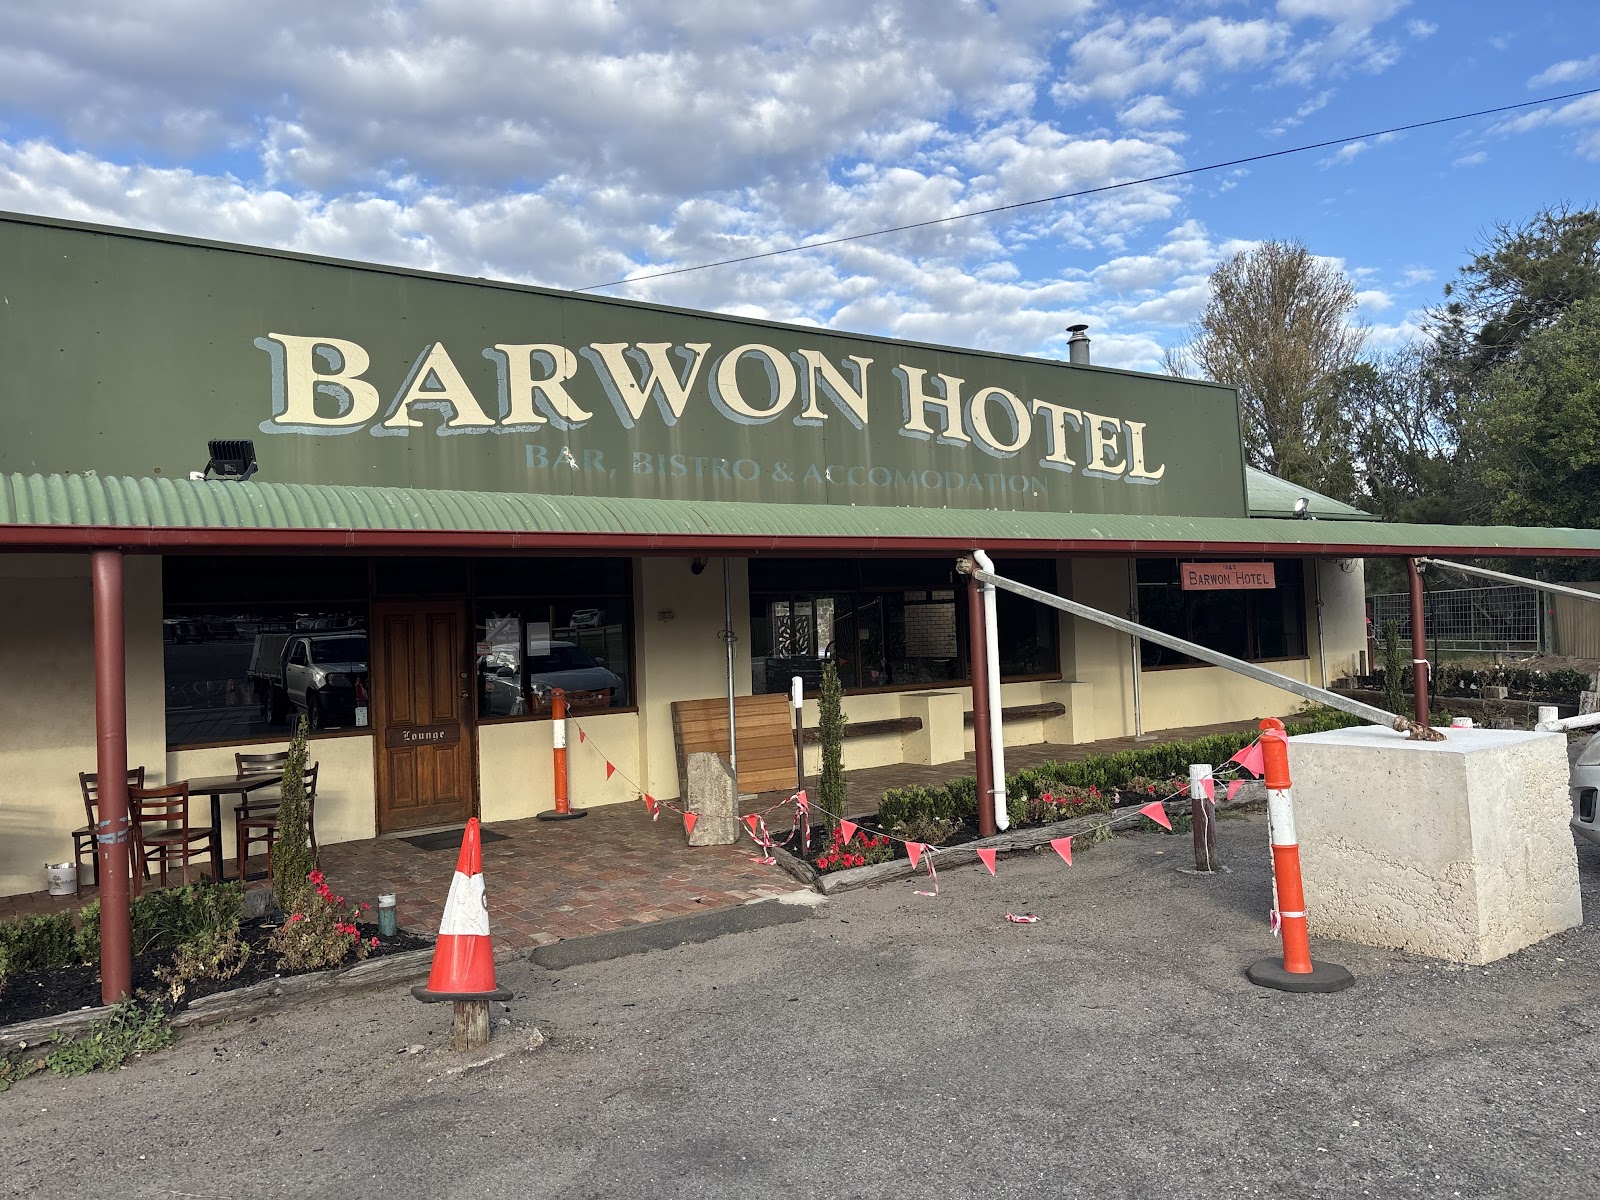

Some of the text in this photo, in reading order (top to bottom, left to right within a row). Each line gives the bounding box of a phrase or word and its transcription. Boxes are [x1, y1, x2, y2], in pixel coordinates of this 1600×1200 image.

[261, 332, 1165, 481] BARWON HOTEL
[525, 443, 1050, 493] BAR, BISTRO & ACCOMODATION
[1188, 571, 1270, 585] BARWON HOTEL
[402, 730, 445, 742] Lounge
